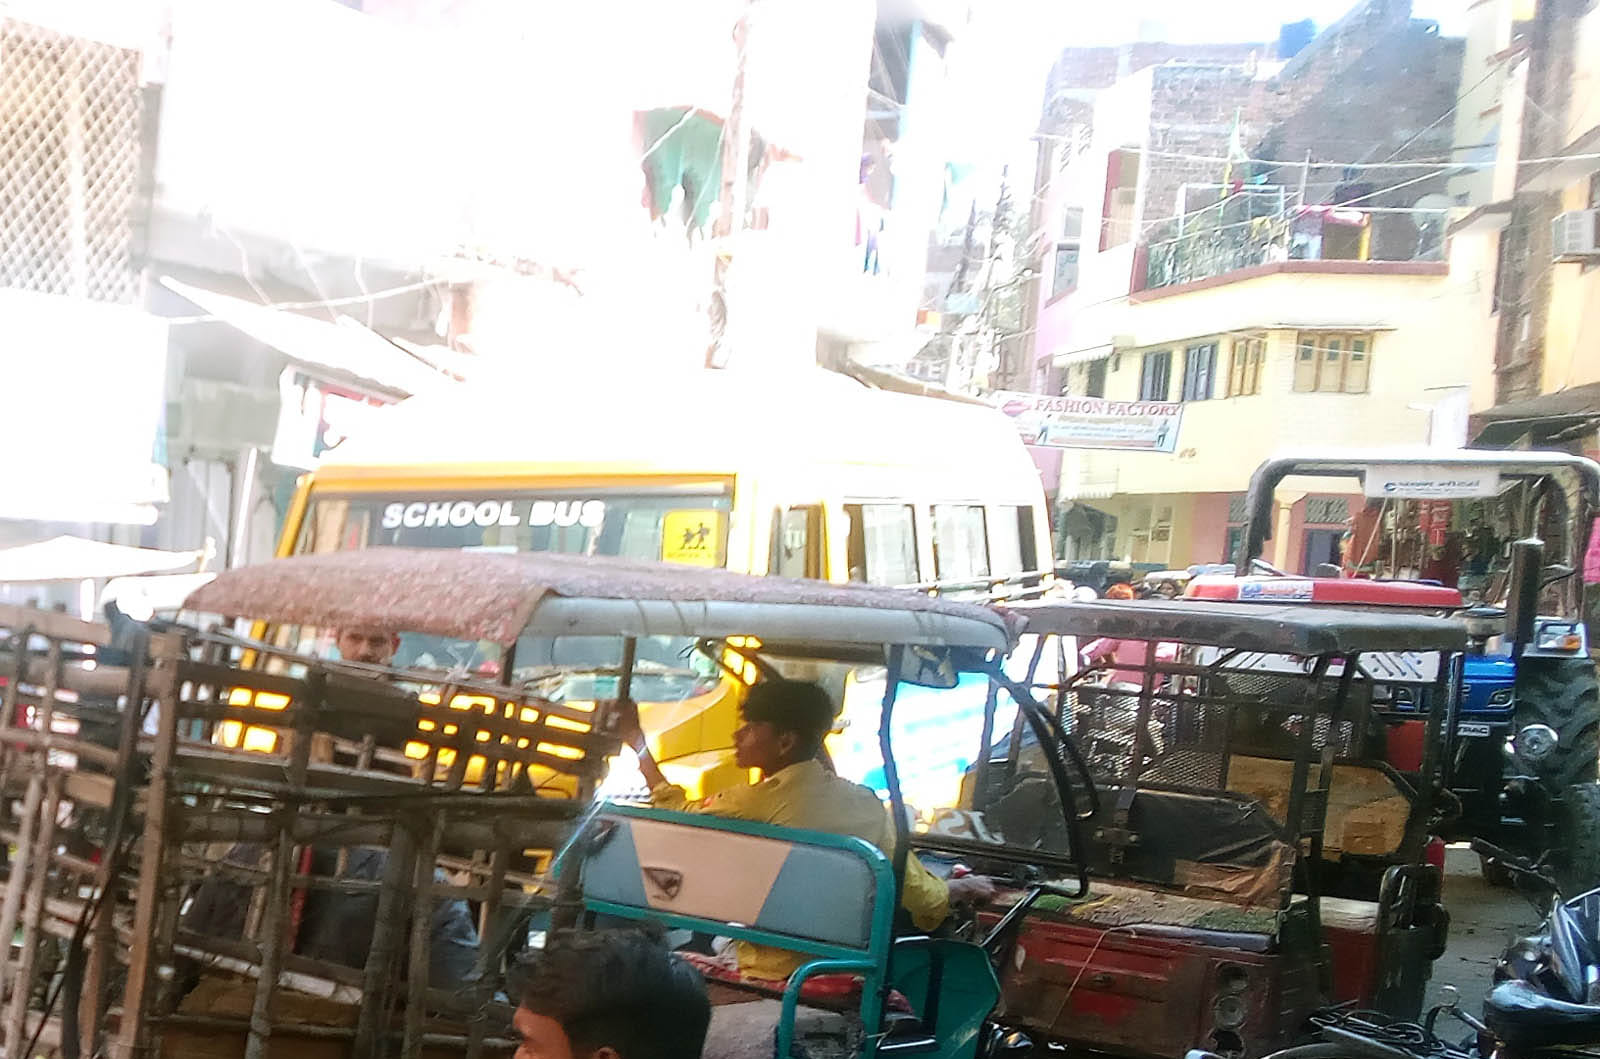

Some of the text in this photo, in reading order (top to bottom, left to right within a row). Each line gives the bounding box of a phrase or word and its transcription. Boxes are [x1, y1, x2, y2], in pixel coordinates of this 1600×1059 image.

[1035, 399, 1180, 417] FASHION FACTORY
[382, 500, 607, 528] SCHOOL BUS
